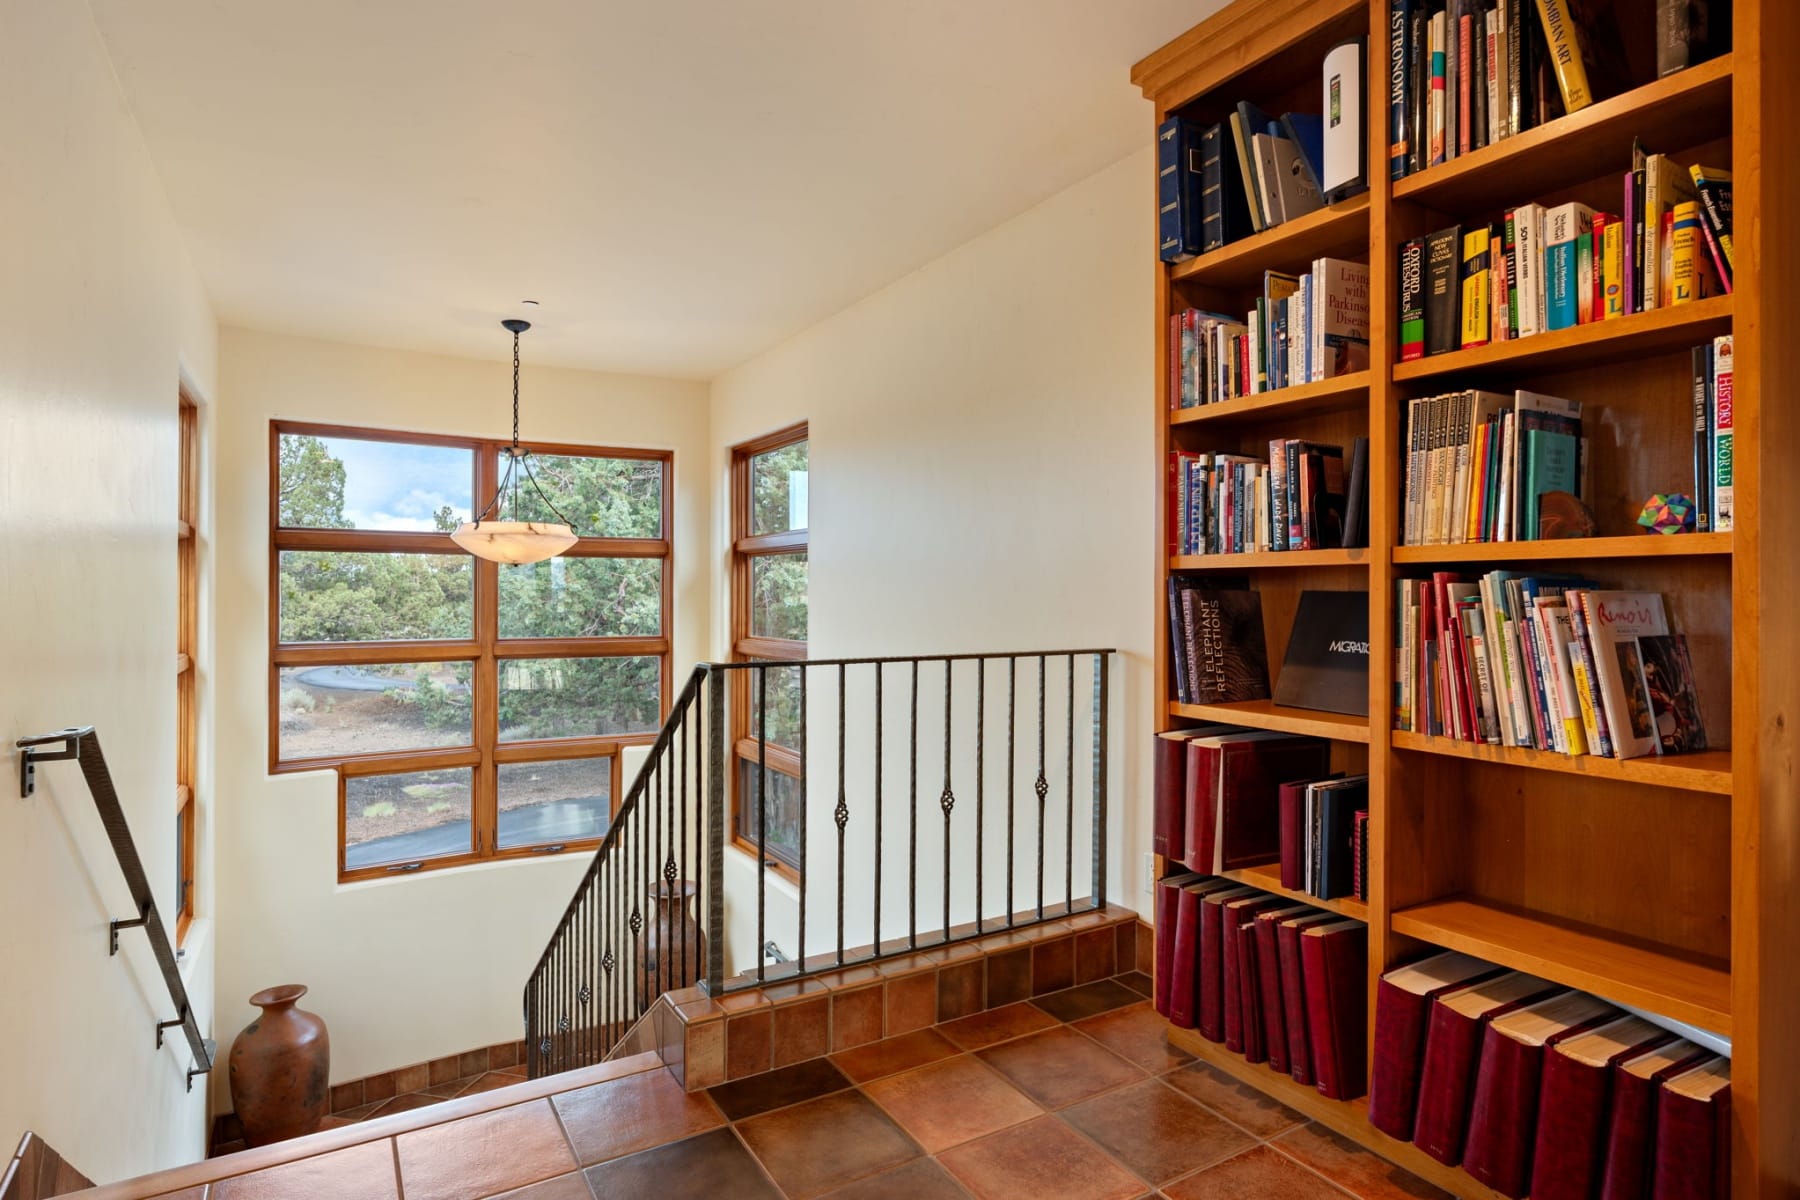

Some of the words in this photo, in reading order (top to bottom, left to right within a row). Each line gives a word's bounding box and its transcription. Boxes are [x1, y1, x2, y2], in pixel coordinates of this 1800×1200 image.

[1392, 10, 1404, 105] ASTRONOMY
[1557, 43, 1572, 65] ART
[1700, 189, 1714, 208] French
[1707, 205, 1723, 231] Essentials
[1345, 284, 1366, 298] with
[1402, 250, 1410, 313] THESAURUS
[1410, 247, 1420, 294] OXFORD
[1677, 285, 1689, 299] L
[1718, 376, 1732, 426] HISTORY
[1718, 436, 1732, 485] WORLD
[1274, 499, 1283, 519] WADE
[1275, 522, 1284, 545] DAVIS
[1556, 614, 1569, 626] THE
[1598, 599, 1653, 627] Renoir
[1200, 600, 1215, 672] ELEPHANT
[1210, 600, 1226, 692] REFLECTIONS
